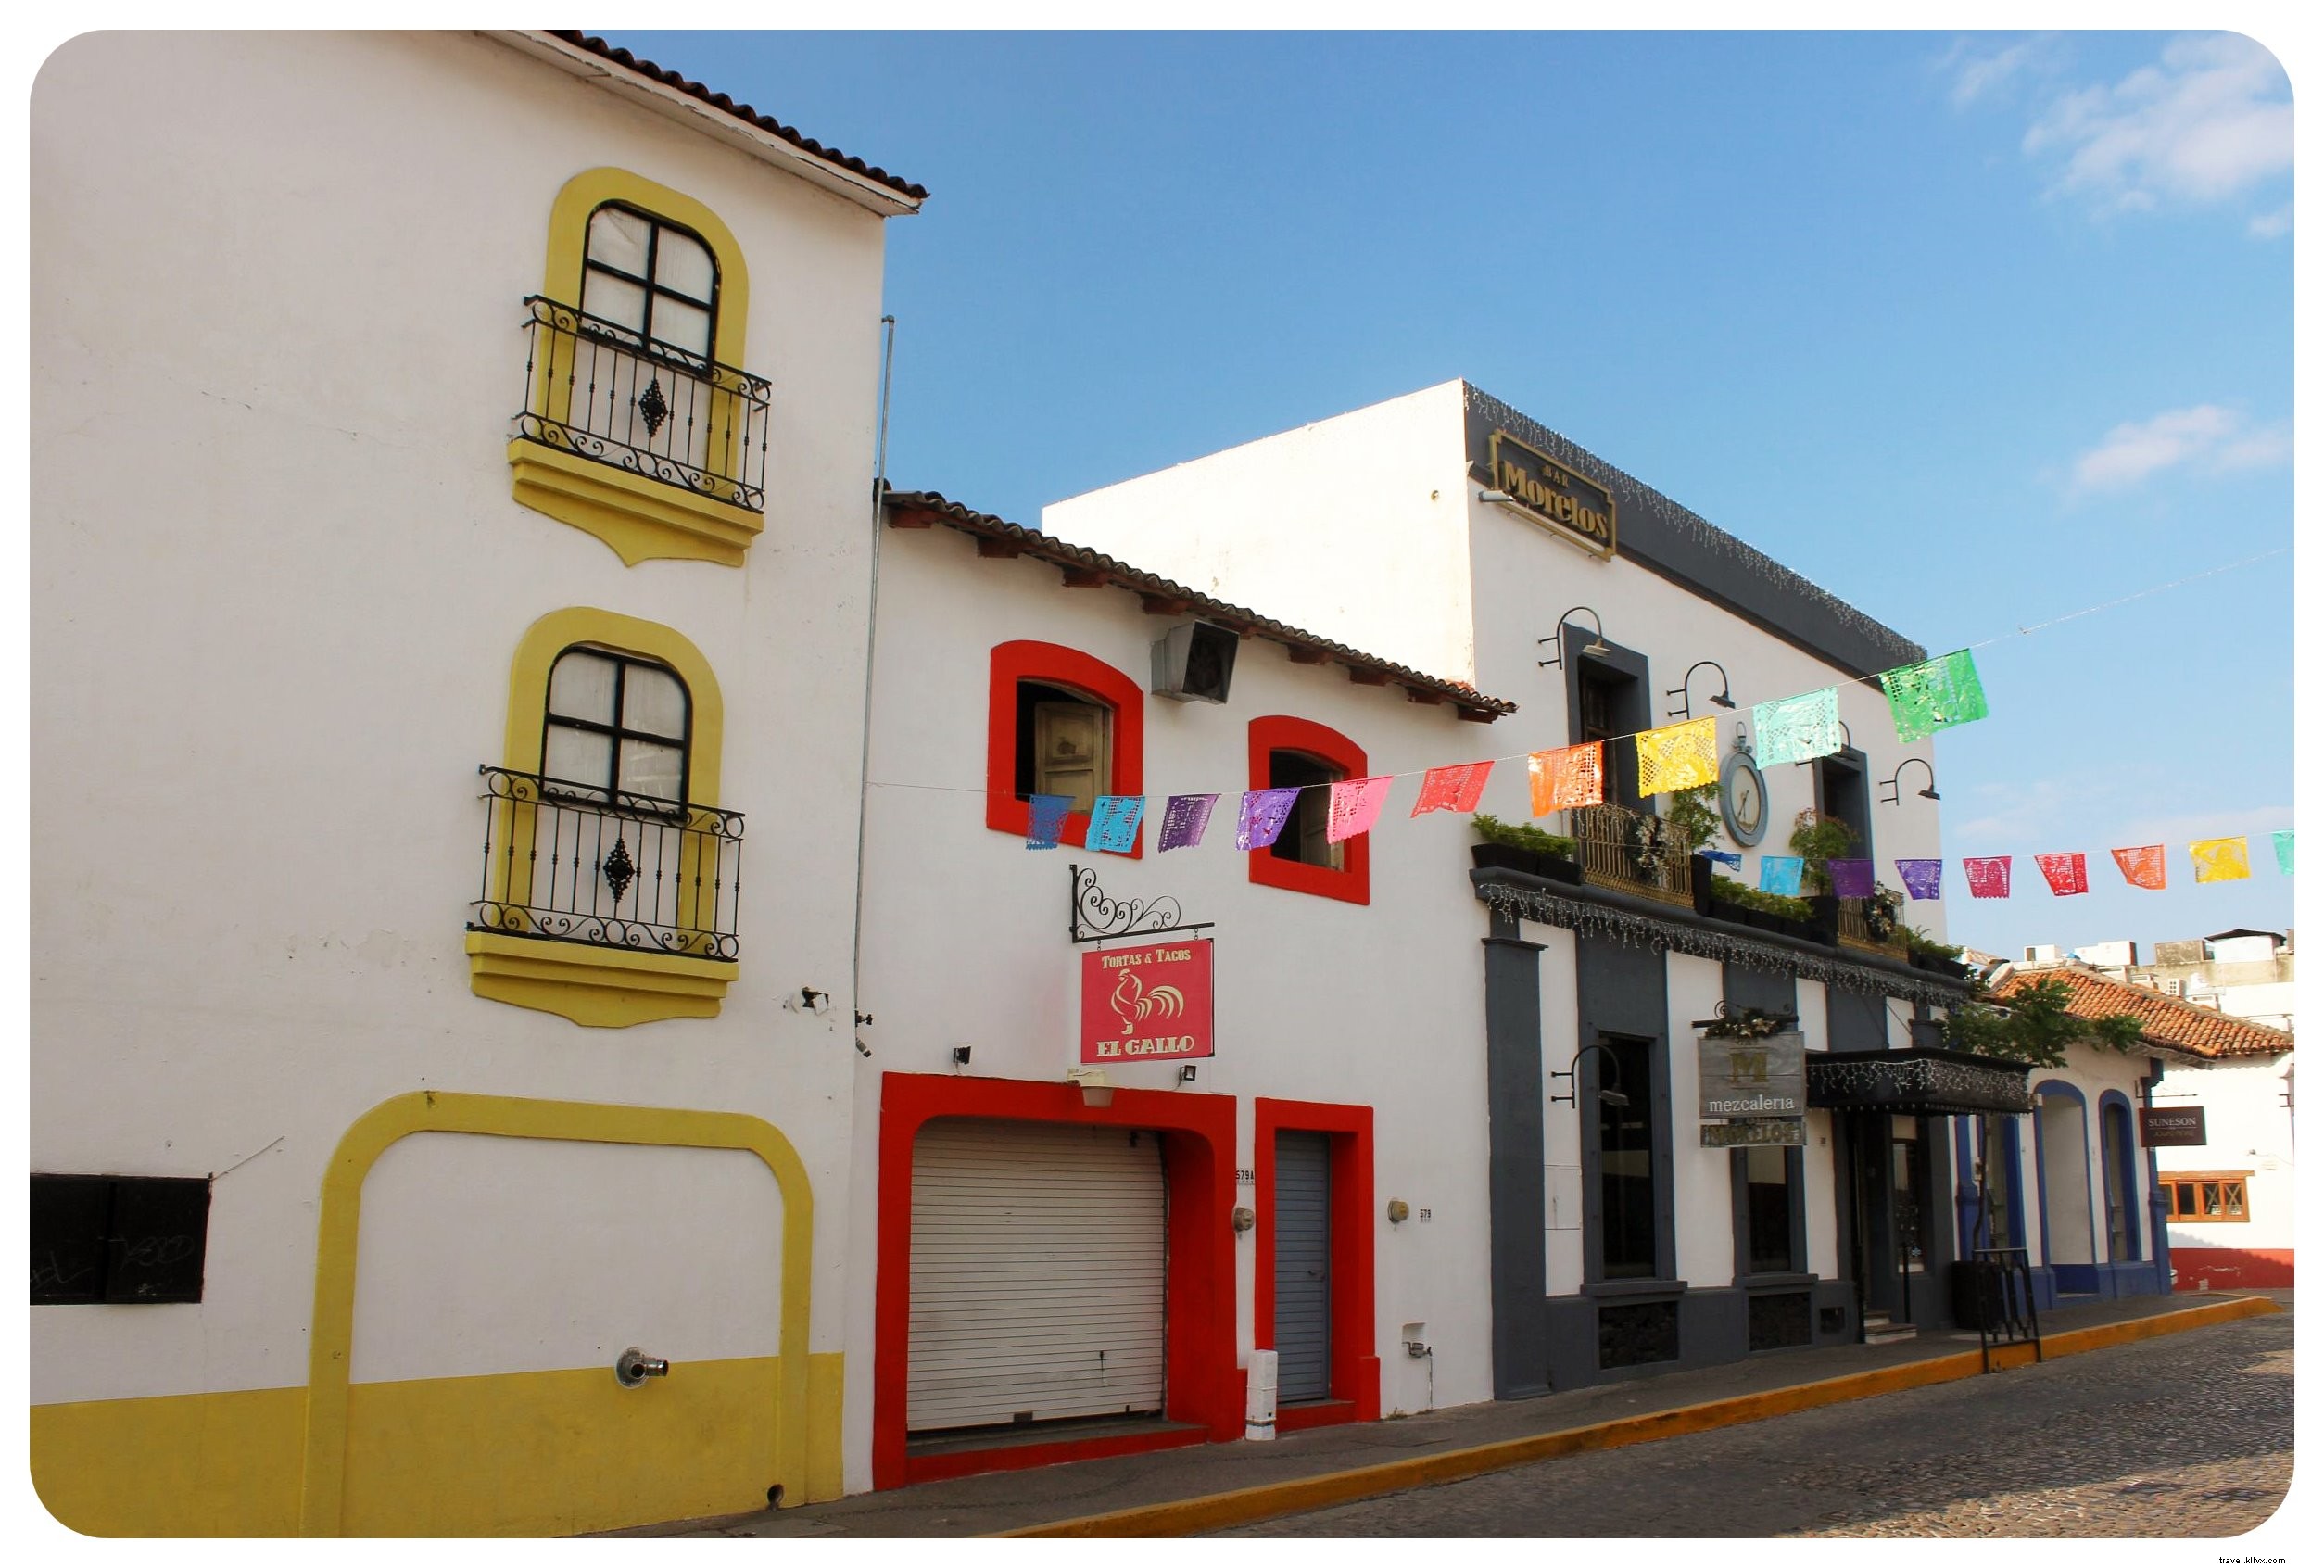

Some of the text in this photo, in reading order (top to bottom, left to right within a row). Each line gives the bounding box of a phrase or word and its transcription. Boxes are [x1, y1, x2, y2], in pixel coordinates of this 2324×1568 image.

[1503, 460, 1608, 538] Morelos
[1101, 948, 1192, 969] TORTAS & TACOS
[1096, 1035, 1195, 1057] EL GALLO
[1729, 1052, 1770, 1083] M
[2148, 1117, 2197, 1127] SUNESON
[1235, 1170, 1255, 1180] 579A
